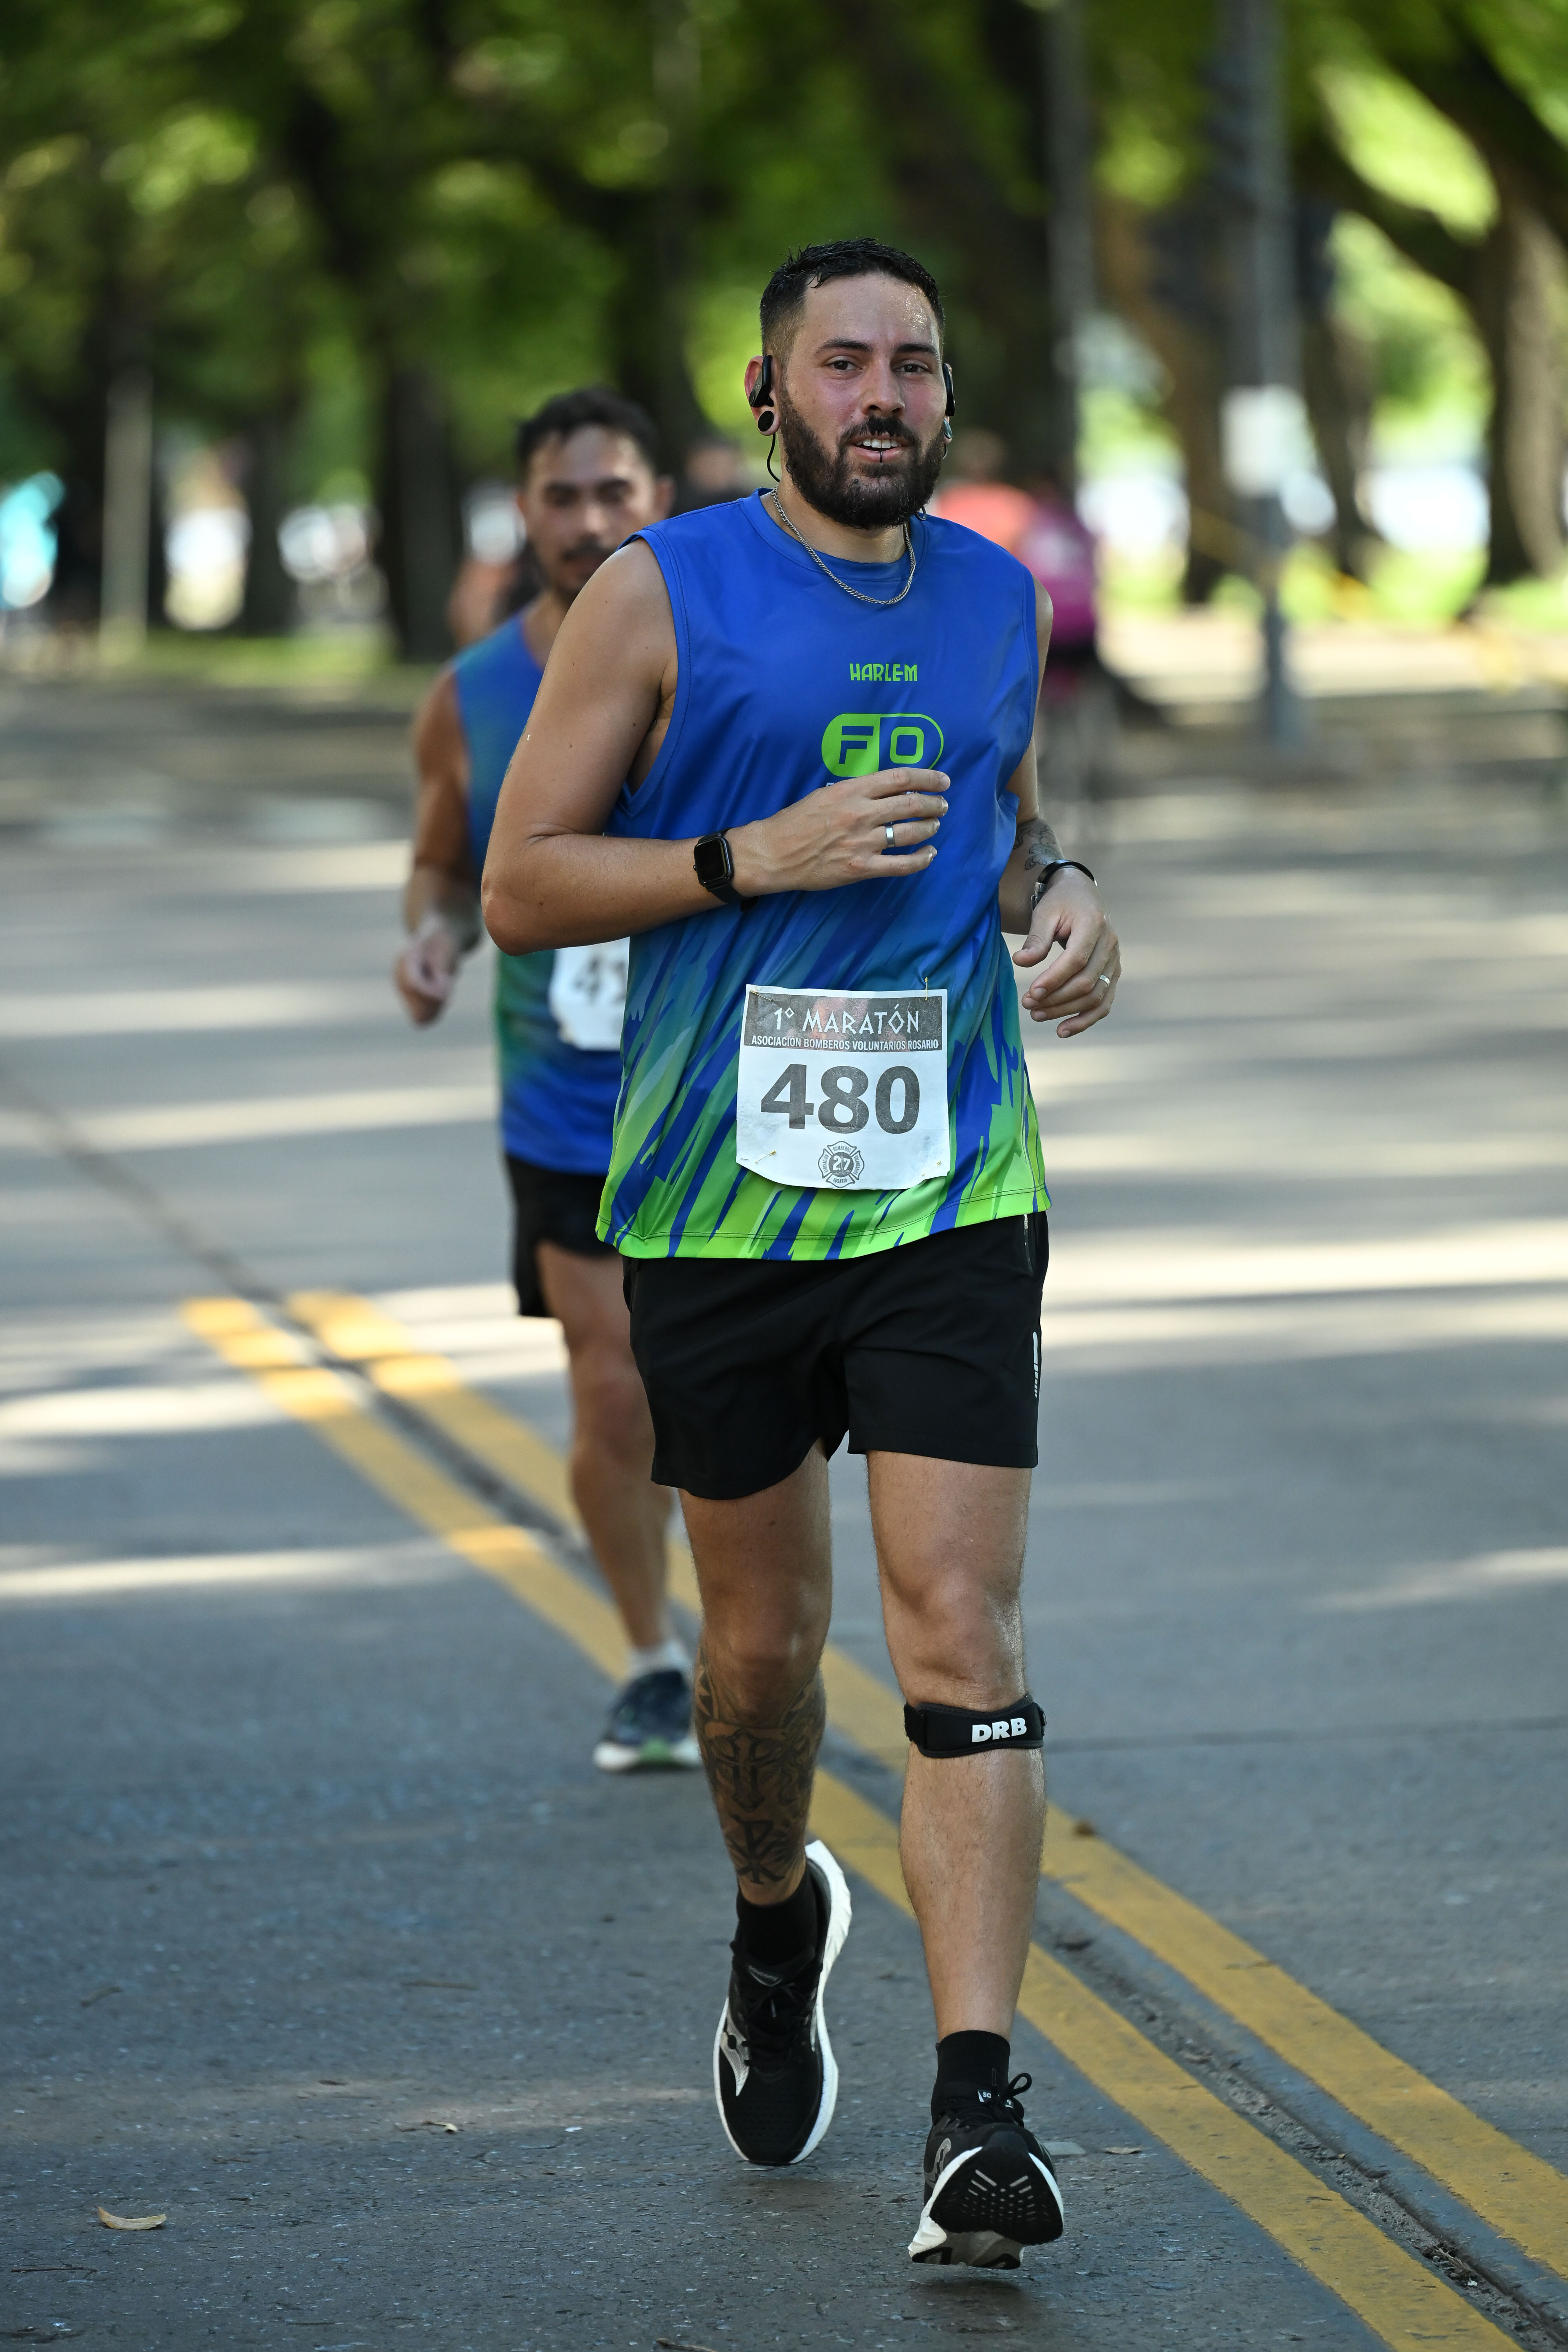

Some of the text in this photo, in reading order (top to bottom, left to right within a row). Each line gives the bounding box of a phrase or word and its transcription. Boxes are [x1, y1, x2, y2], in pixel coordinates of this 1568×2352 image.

[850, 663, 917, 681] HARLEM
[802, 1003, 919, 1035] MARATÓN
[751, 1035, 938, 1050] ASOCIACIÓN BOMBEROS VOLUNTARIOS ROSARIO
[761, 1064, 920, 1134] 480
[833, 1155, 850, 1171] 27
[972, 1718, 1027, 1742] DRB
